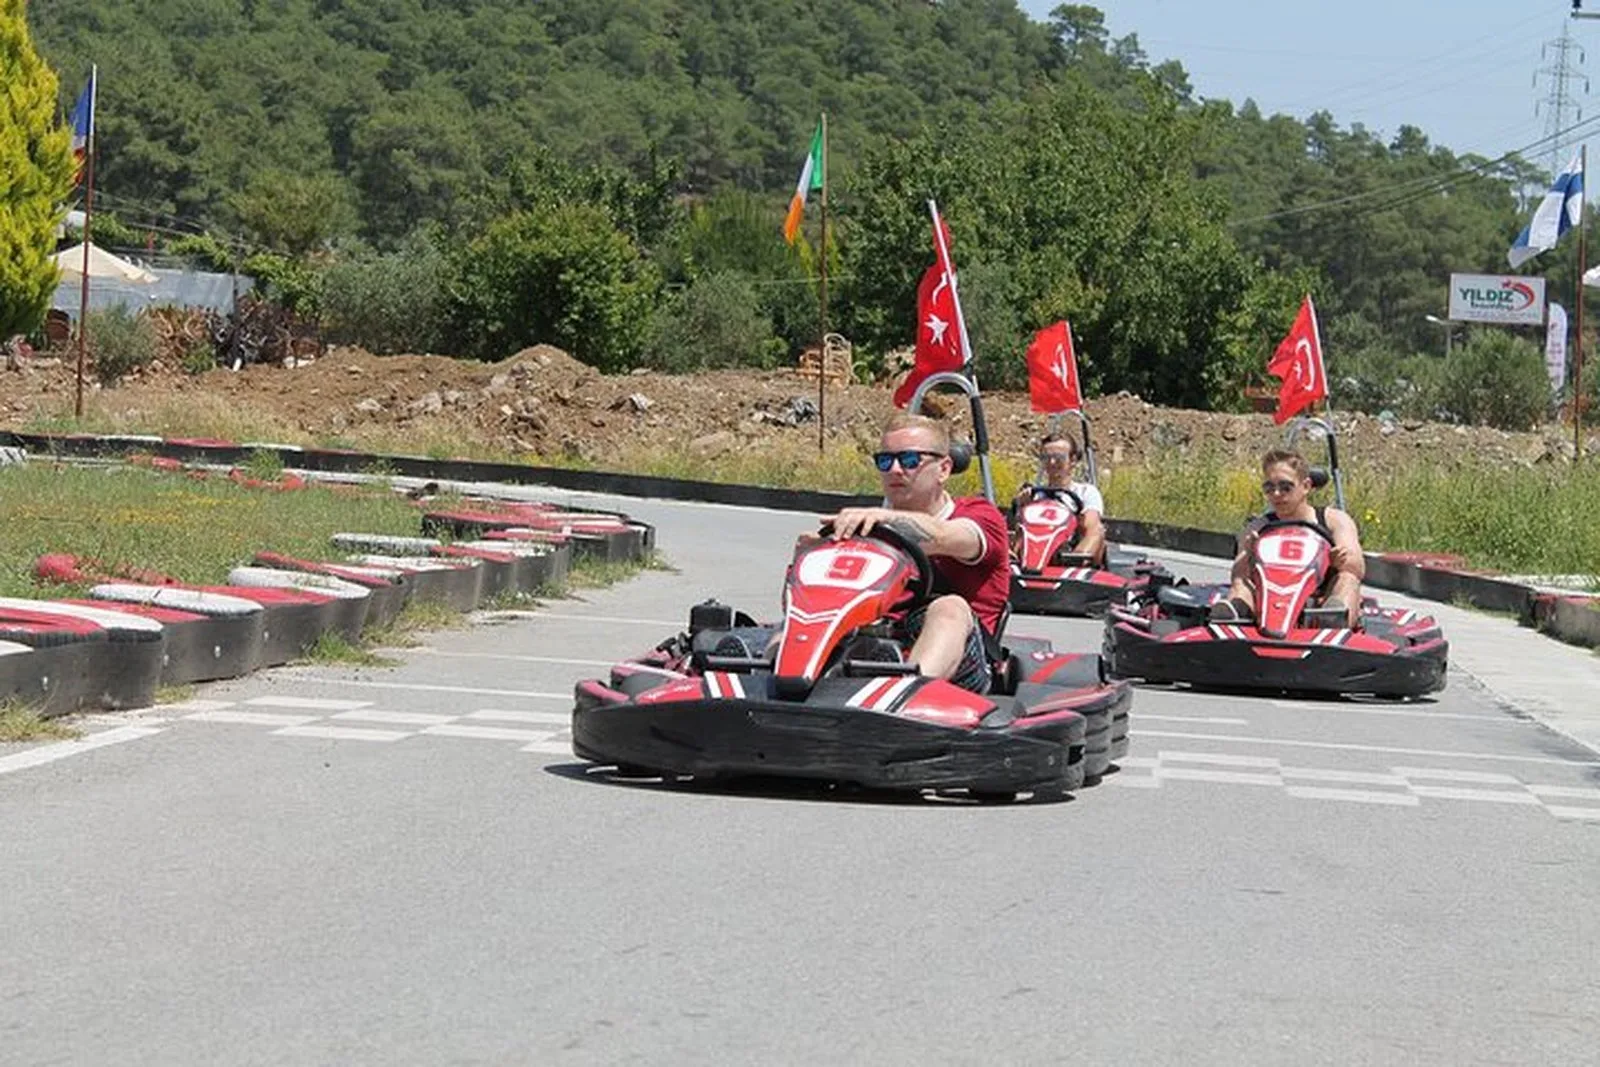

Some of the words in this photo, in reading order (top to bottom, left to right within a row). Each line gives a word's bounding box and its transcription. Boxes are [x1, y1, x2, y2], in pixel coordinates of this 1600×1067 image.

[1459, 287, 1513, 302] YILDIZ
[1040, 508, 1057, 521] 4
[1279, 540, 1304, 560] 6
[828, 555, 868, 580] 9
